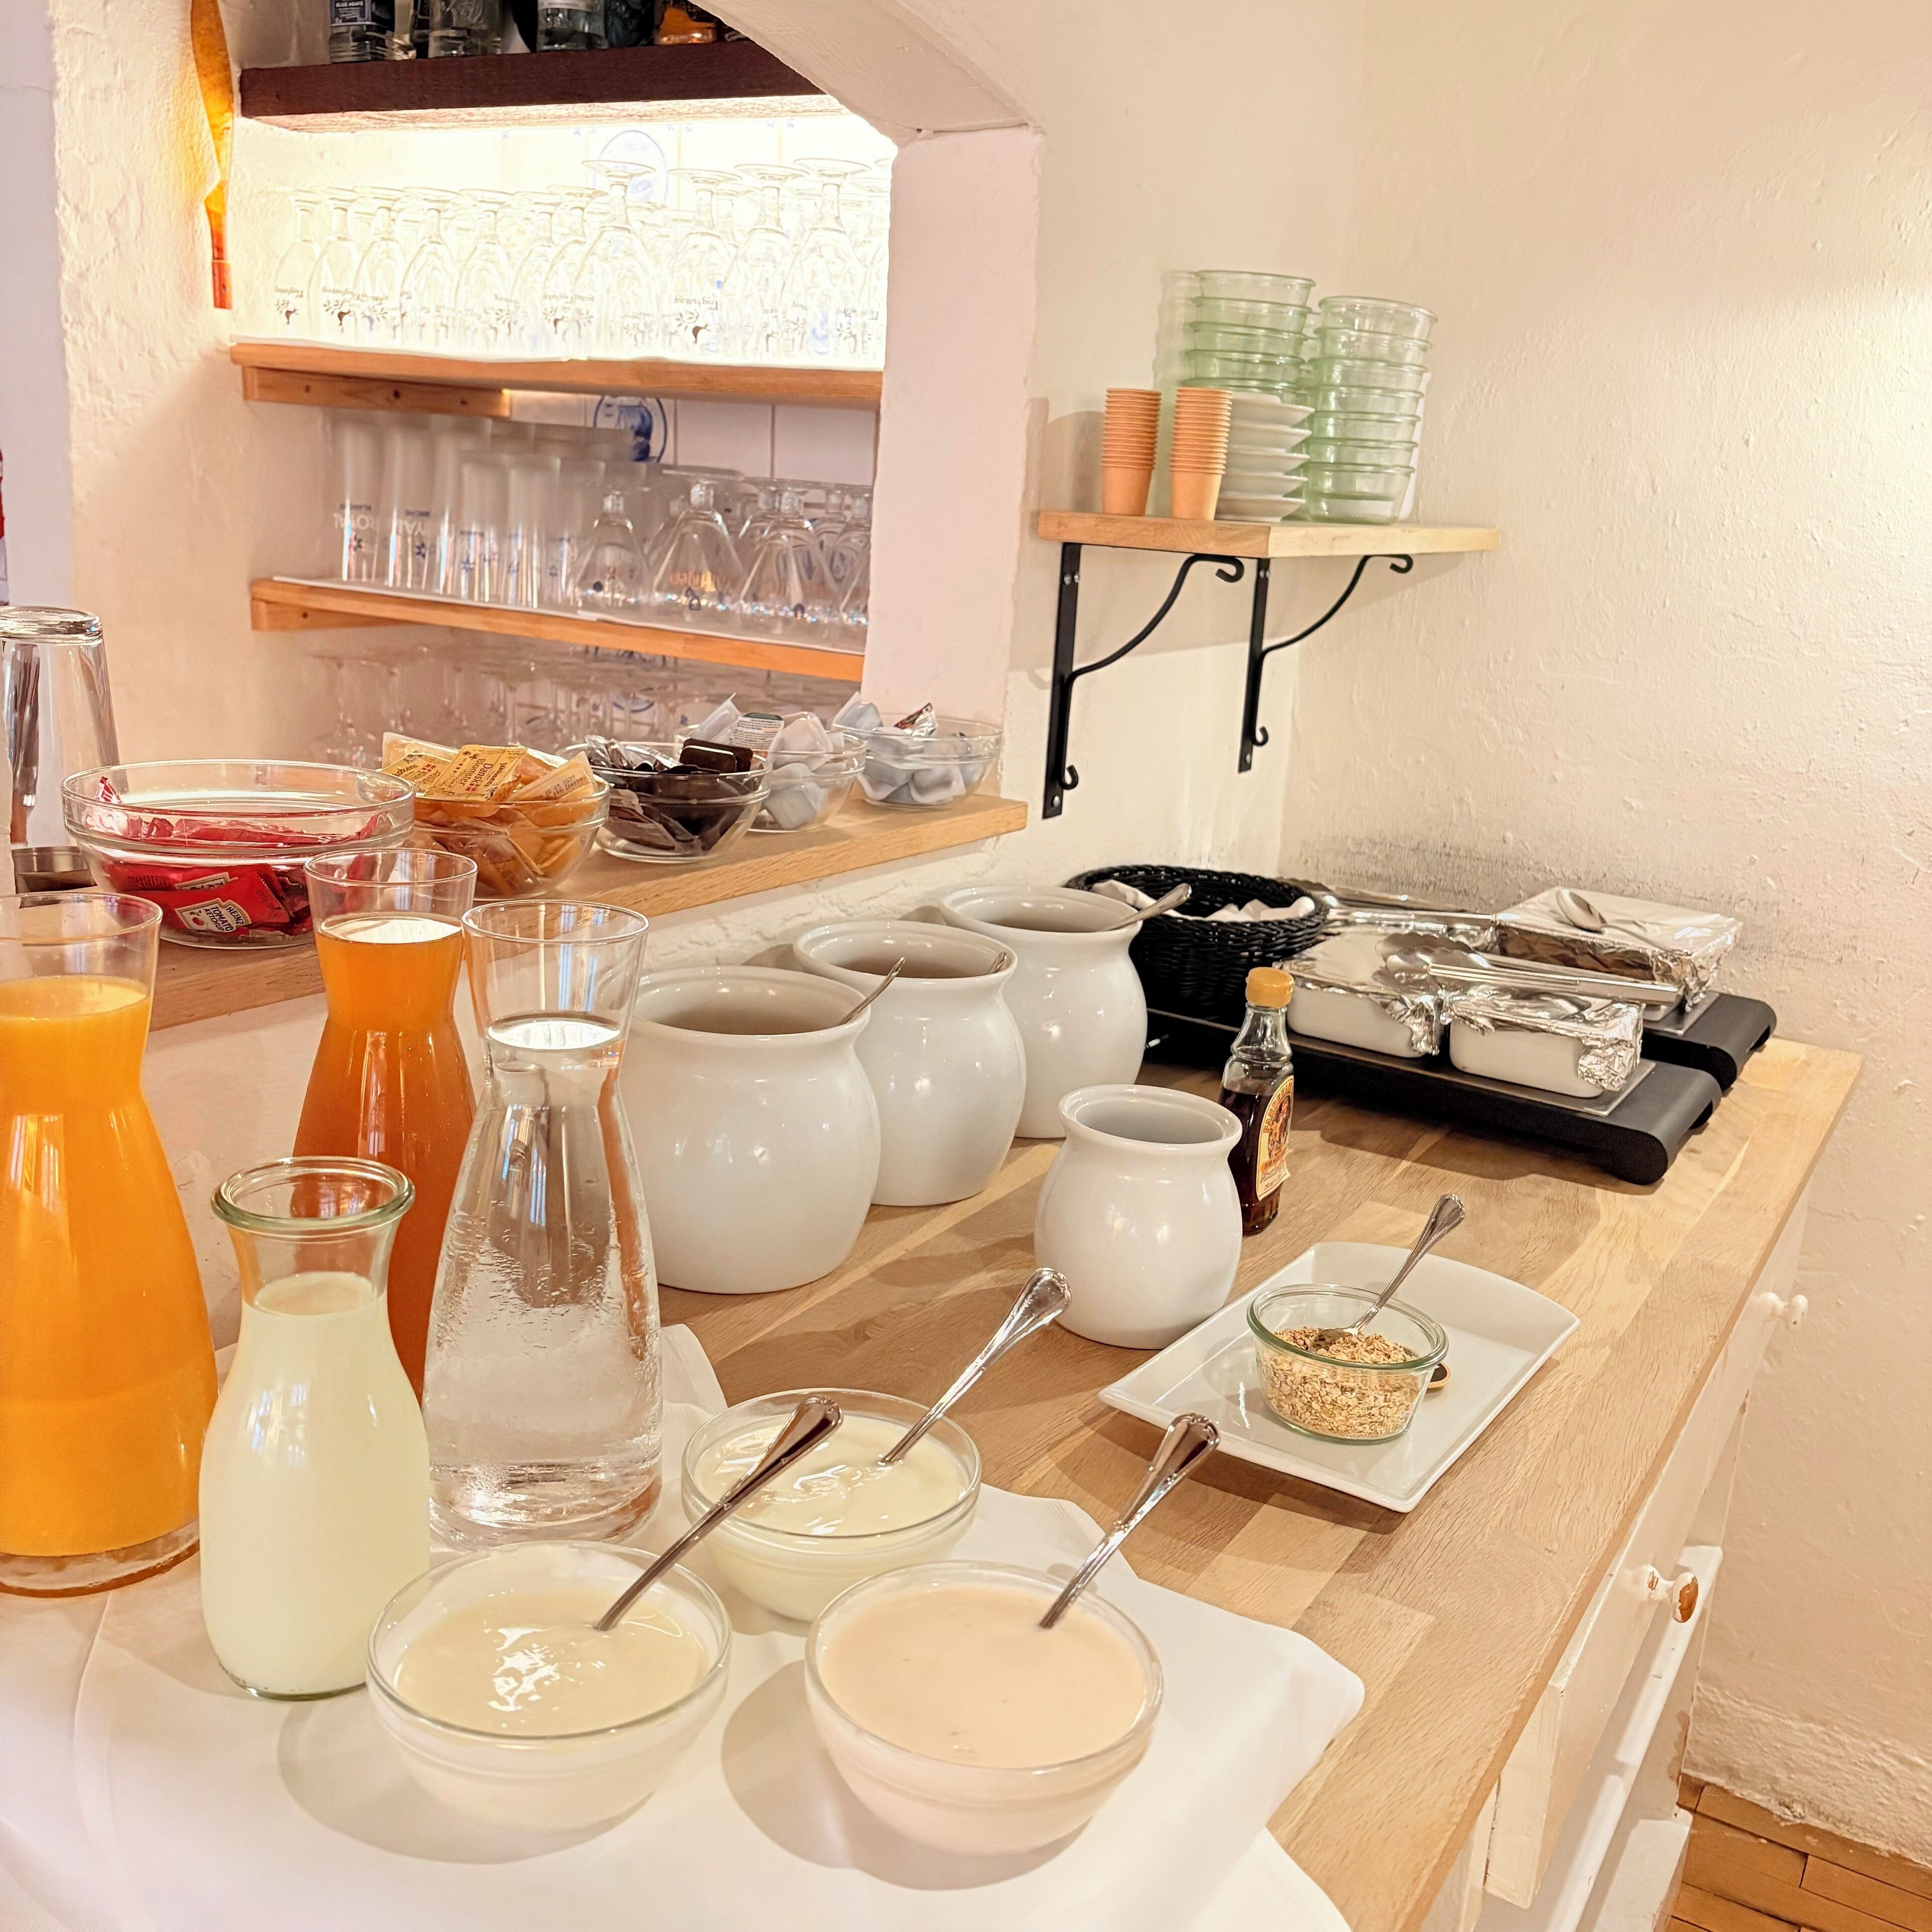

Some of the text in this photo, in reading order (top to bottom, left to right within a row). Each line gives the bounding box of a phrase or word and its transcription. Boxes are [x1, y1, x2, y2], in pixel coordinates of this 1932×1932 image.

[472, 763, 494, 784] Dansk
[204, 908, 225, 932] KETCHUP
[210, 906, 234, 931] TOMATO
[226, 906, 245, 925] HEINZ
